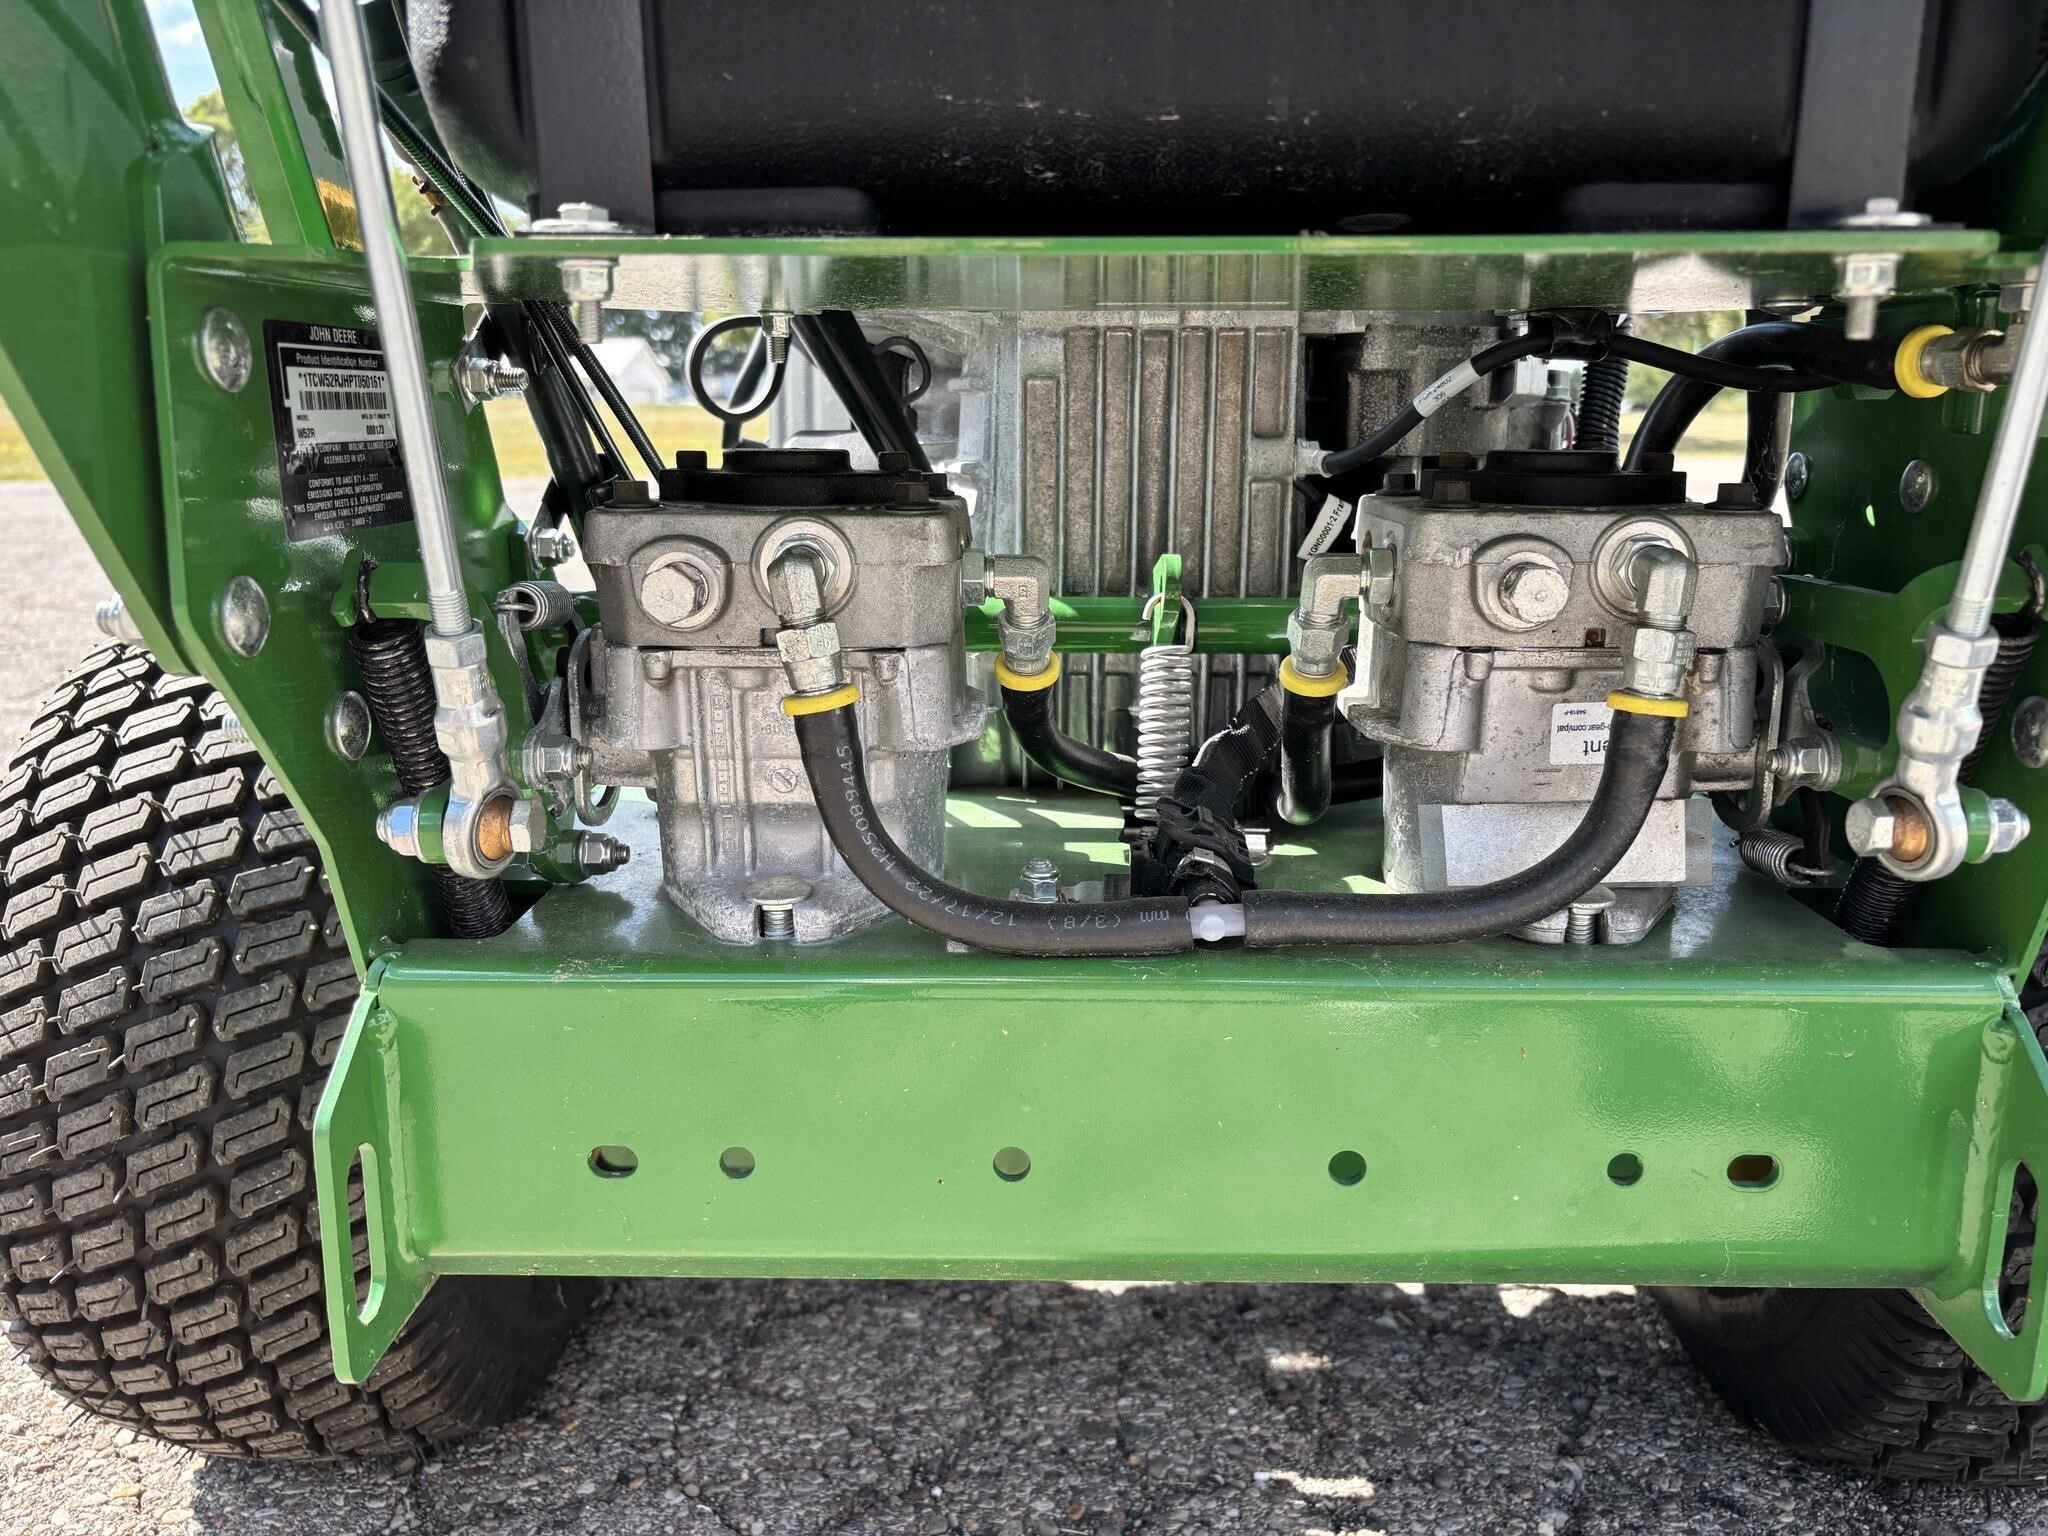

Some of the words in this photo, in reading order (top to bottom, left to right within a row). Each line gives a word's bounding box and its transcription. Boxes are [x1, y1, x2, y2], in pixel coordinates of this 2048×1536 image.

[309, 326, 332, 342] JOHN
[332, 328, 358, 344] DEERE
[296, 352, 320, 365] Product
[321, 354, 357, 367] Identification
[358, 356, 378, 368] Number
[297, 428, 316, 439] W52R
[324, 454, 350, 464] ASSEMBLED
[351, 454, 357, 463] IN
[308, 477, 335, 488] CONFORMS
[336, 476, 341, 485] TO
[342, 475, 353, 485] ANSI
[307, 489, 333, 499] EMISSIONS
[334, 486, 354, 496] CONTROL
[355, 483, 383, 494] INFORMATION
[294, 504, 306, 513] THIS
[306, 501, 334, 512] EQUIPMENT
[334, 499, 349, 509] MEETS
[360, 496, 369, 505] EPA
[380, 490, 404, 500] STANDARDS
[314, 510, 337, 521] EMISSION
[836, 744, 899, 872] H25089445
[1140, 910, 1170, 922] mm
